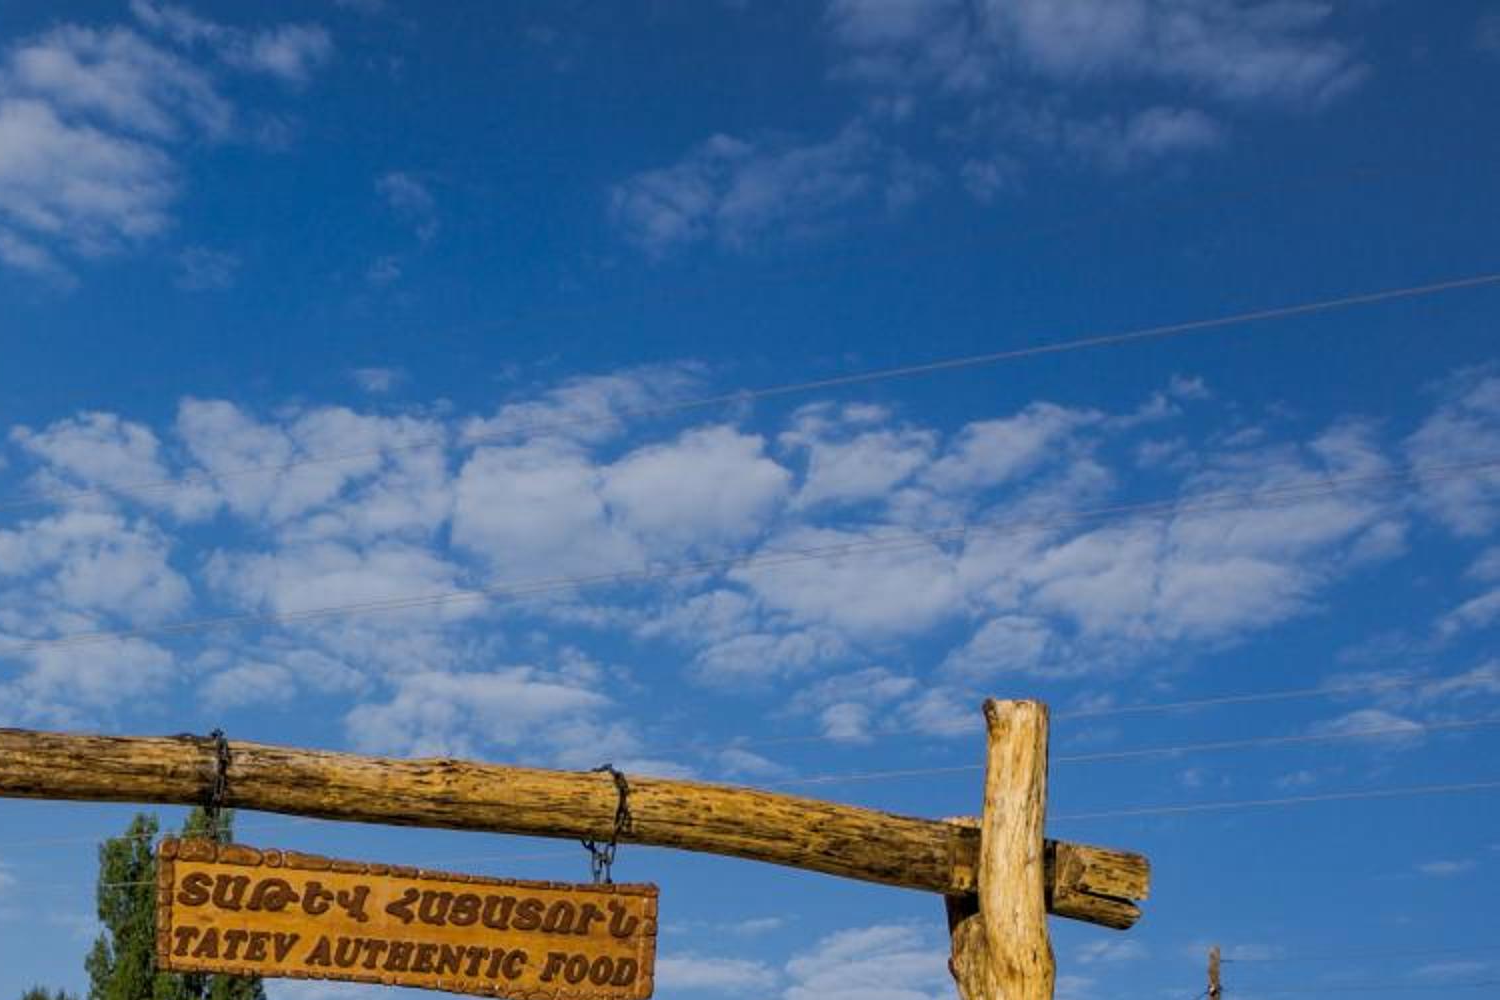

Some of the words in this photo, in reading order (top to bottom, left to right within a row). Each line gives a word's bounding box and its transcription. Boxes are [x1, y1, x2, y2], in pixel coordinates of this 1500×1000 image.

[176, 871, 371, 922] ՏԱԹԵՎ
[385, 887, 641, 939] ՀԱՑԱՏՈՒՆ
[173, 925, 300, 963] TATEV
[304, 934, 528, 980] AUTHENTIC
[539, 951, 639, 987] FOOD
